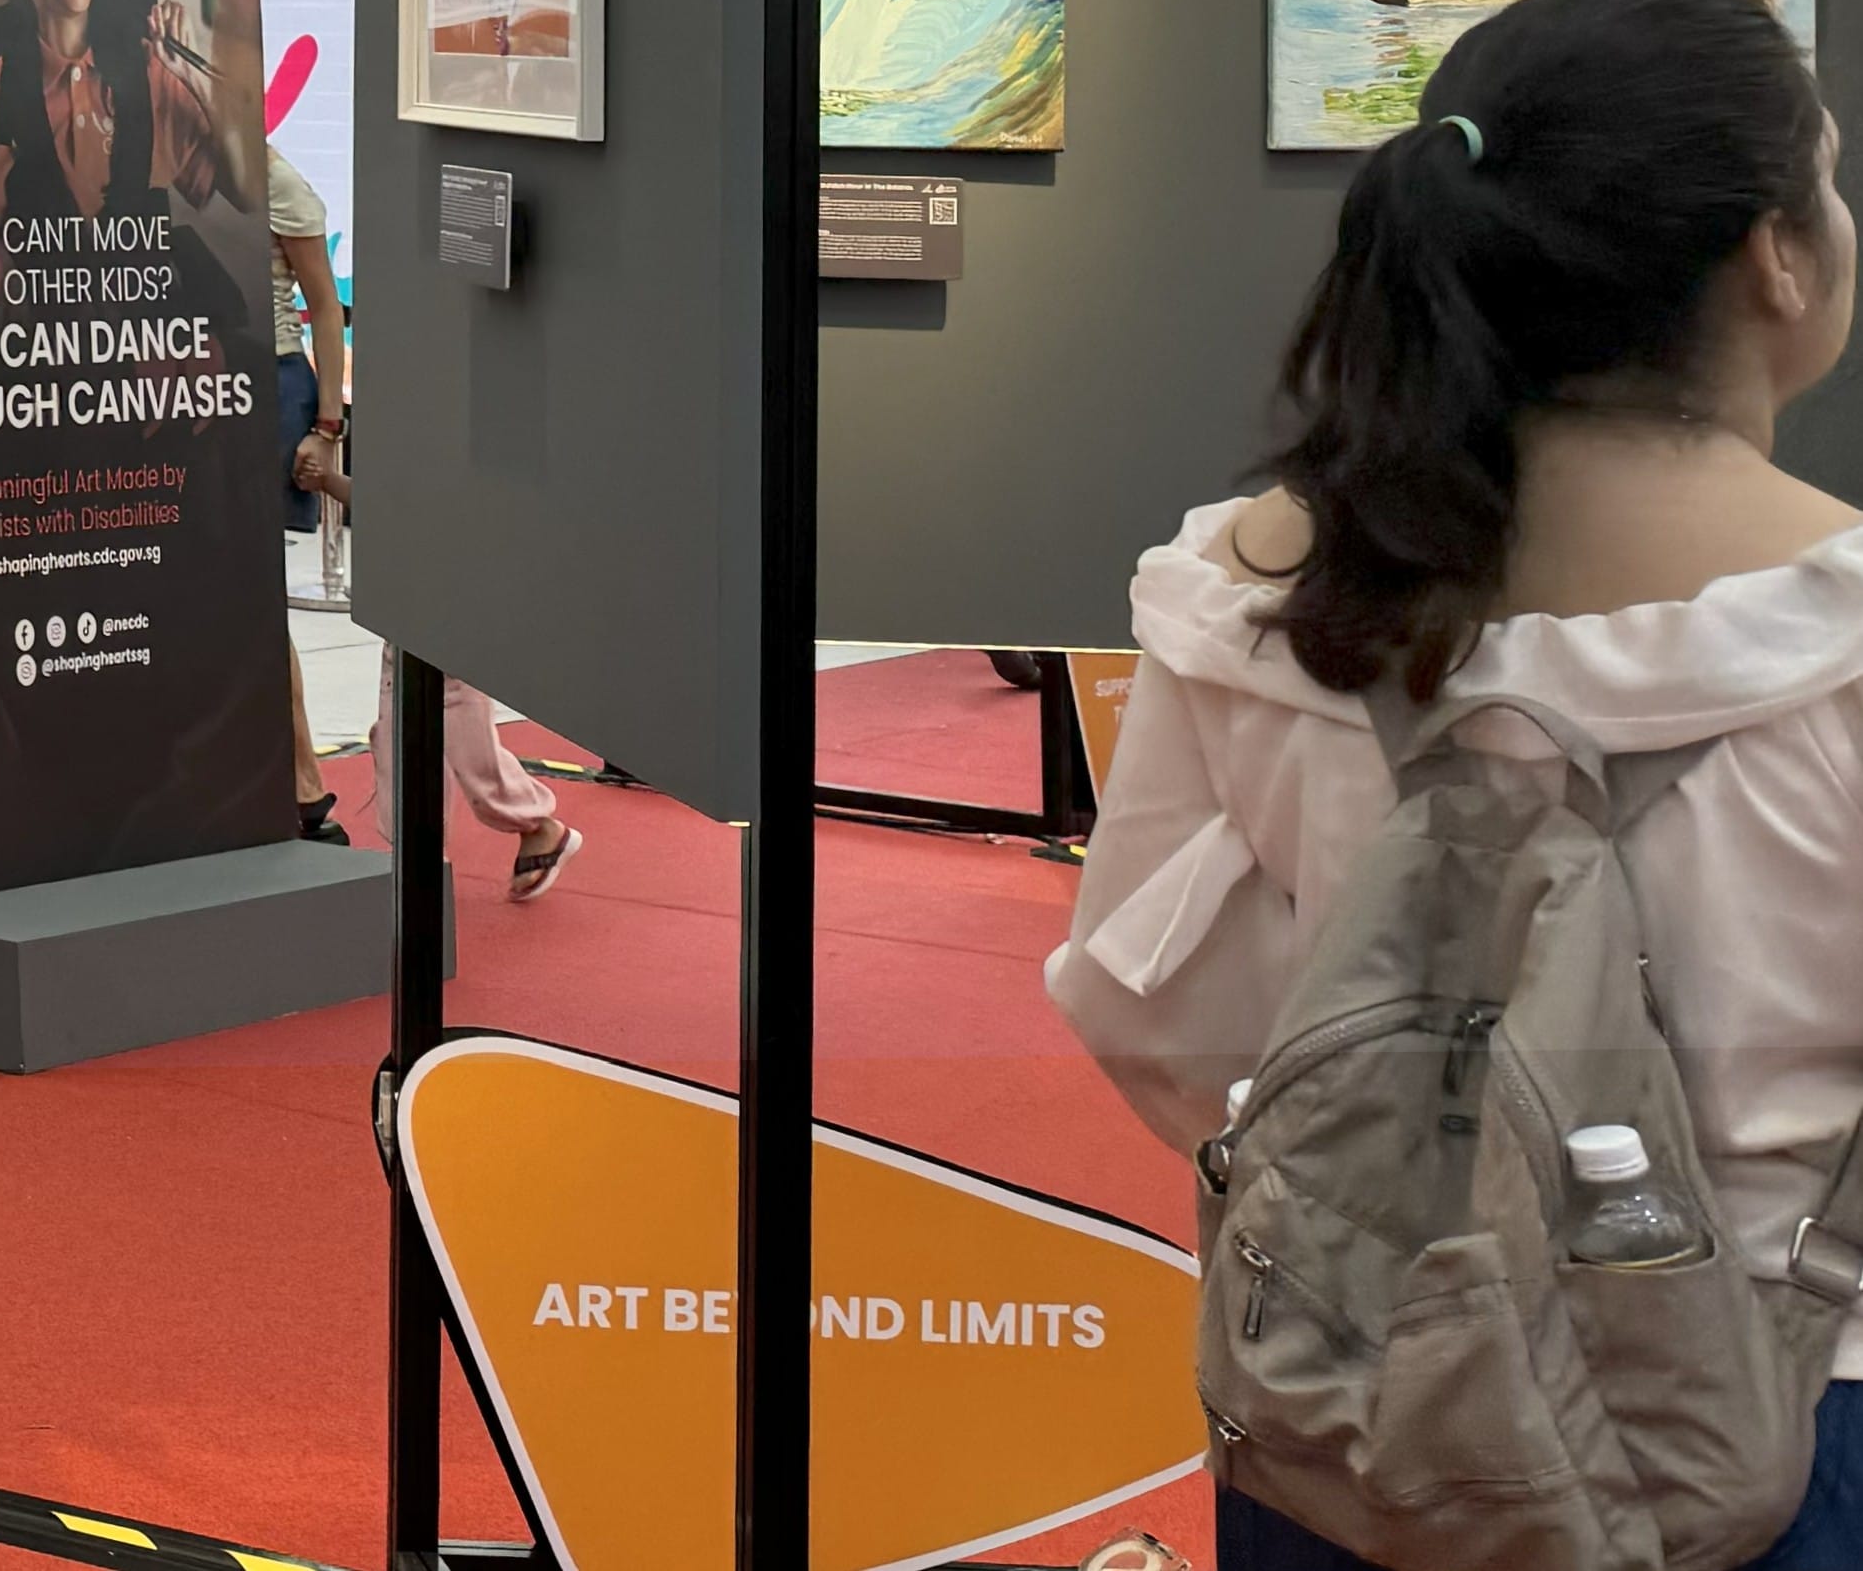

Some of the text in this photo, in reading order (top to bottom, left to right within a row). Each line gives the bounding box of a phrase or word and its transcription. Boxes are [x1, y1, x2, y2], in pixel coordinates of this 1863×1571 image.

[3, 216, 84, 253] CAN'T
[93, 215, 171, 252] MOVE
[3, 267, 93, 305] OTHER
[100, 265, 173, 303] KIDS?
[0, 320, 81, 368] CAN
[89, 316, 211, 364] DANCE
[67, 372, 253, 425] CANVASES
[75, 468, 102, 493] Art
[106, 463, 159, 491] Made
[163, 462, 187, 493] by
[36, 507, 75, 534] with
[81, 499, 180, 531] Disabilities
[102, 612, 150, 637] @necdc
[41, 647, 151, 677] @shapingheartssg
[532, 1283, 1107, 1349] ART BEND LIMITS
